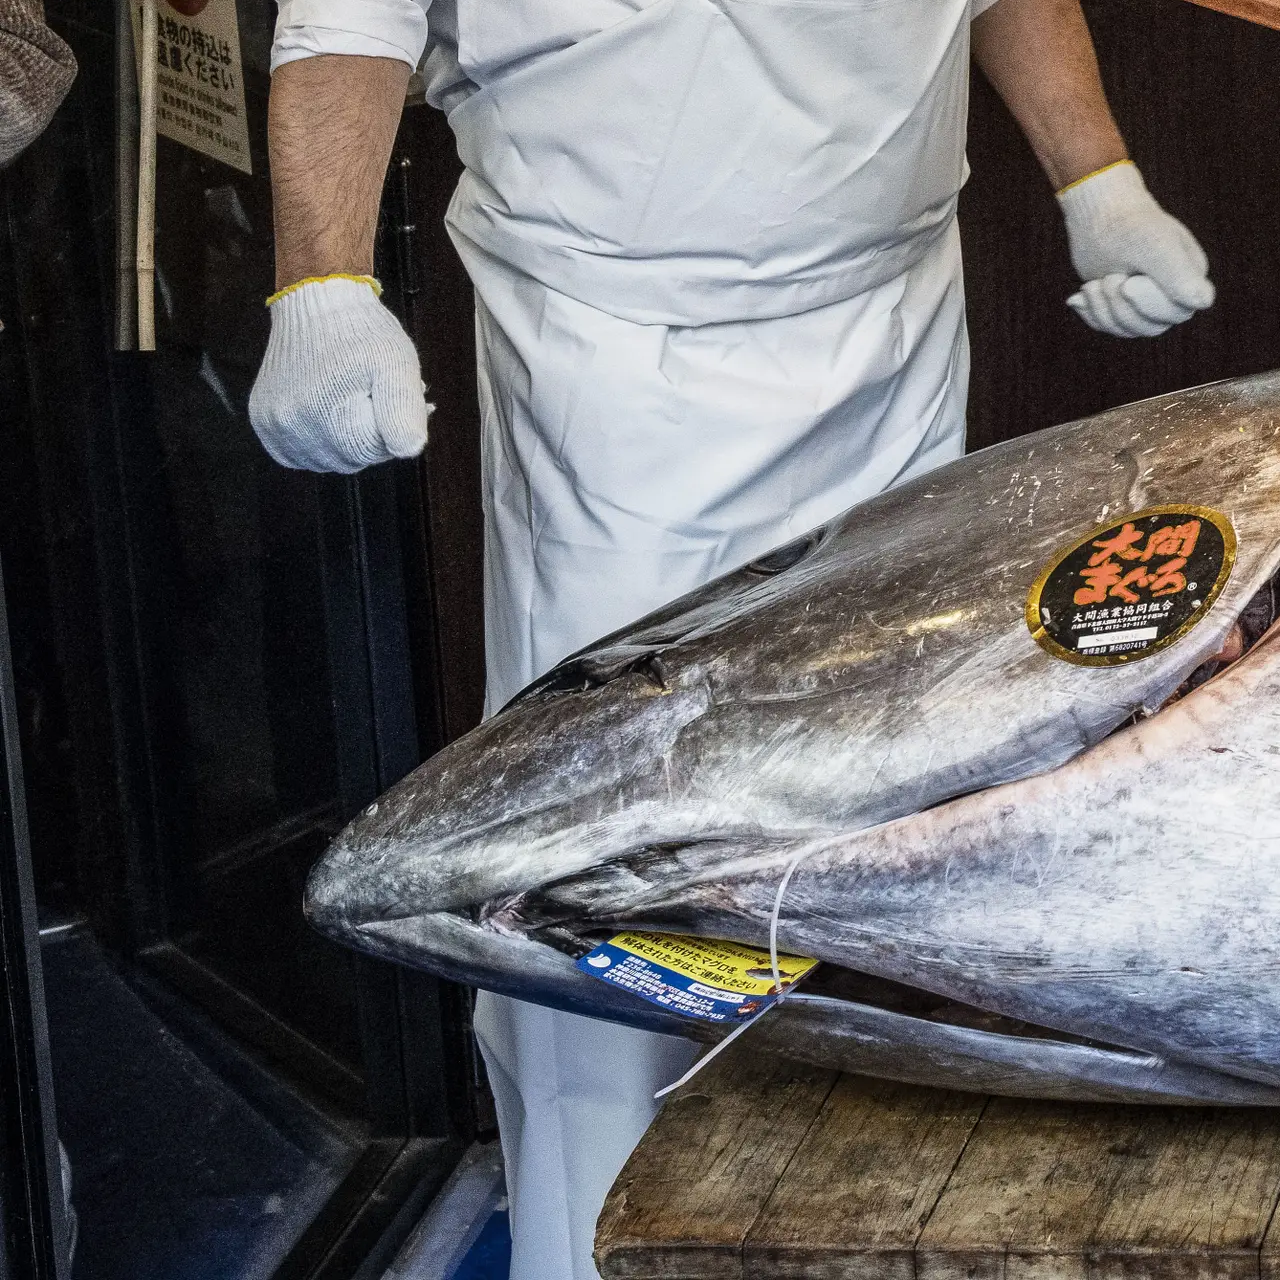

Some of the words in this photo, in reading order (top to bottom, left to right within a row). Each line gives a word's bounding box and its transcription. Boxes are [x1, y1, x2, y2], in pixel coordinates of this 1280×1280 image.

[1087, 519, 1201, 567] 大間
[1073, 557, 1188, 605] まぐろ
